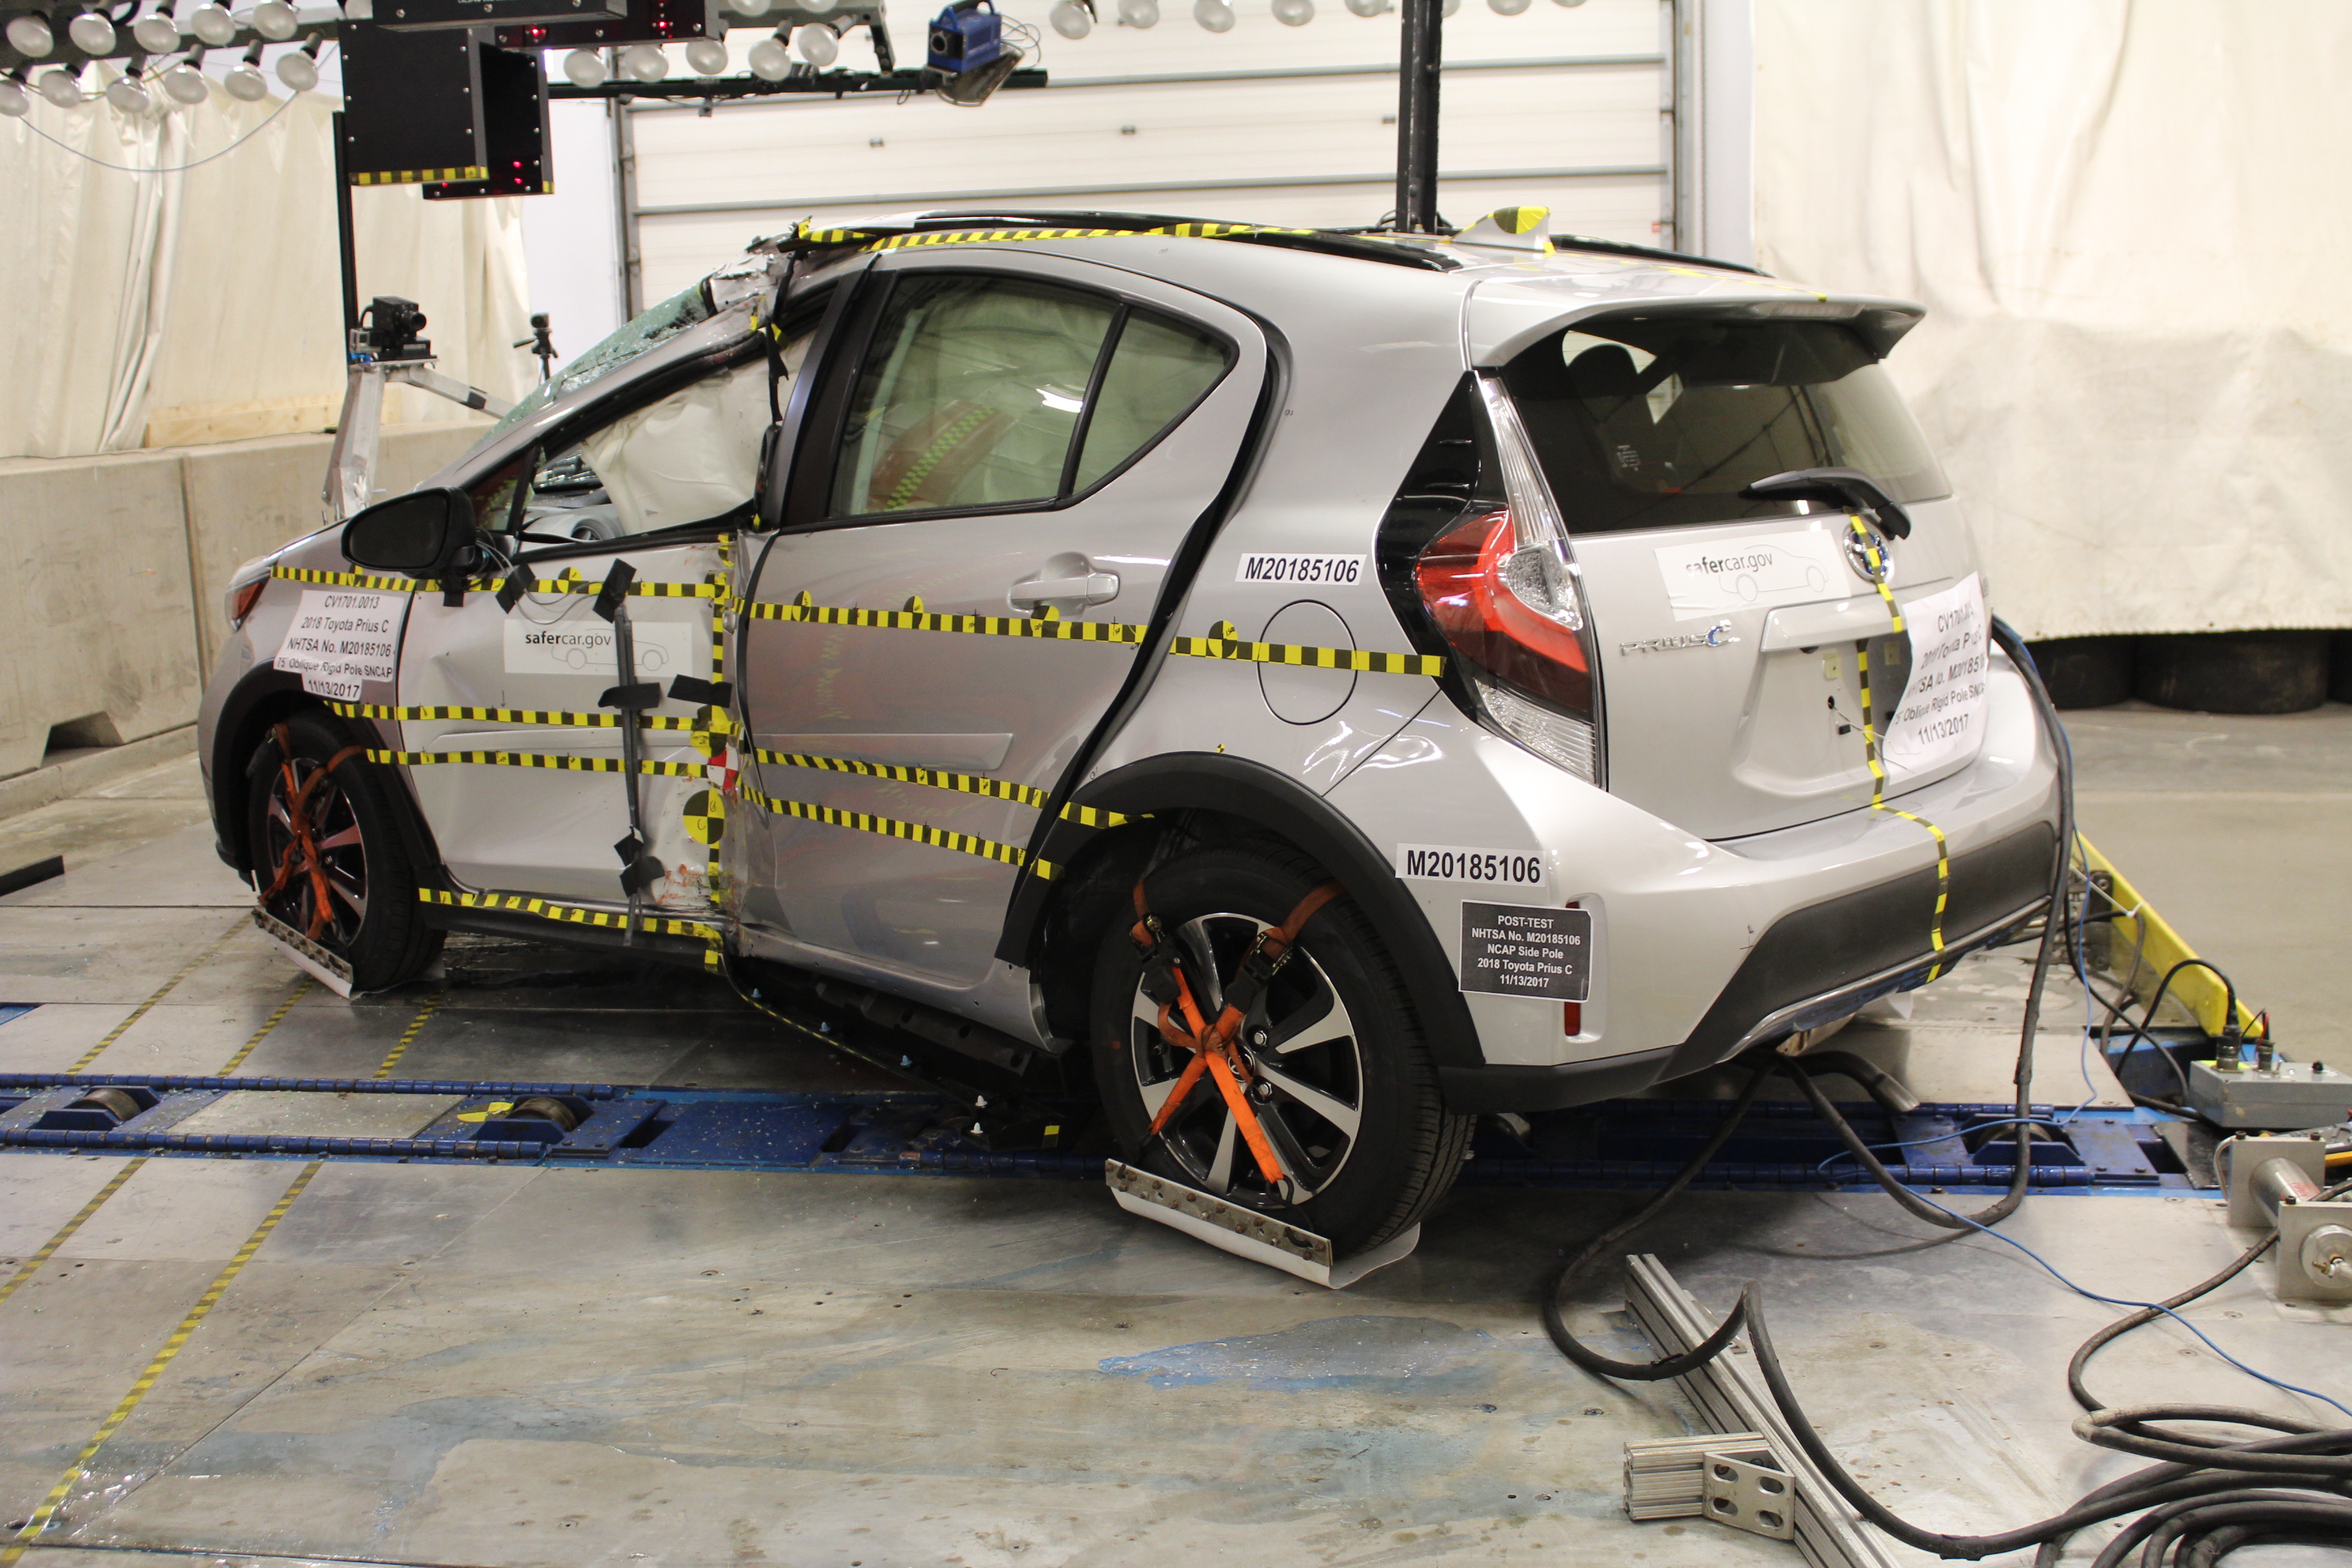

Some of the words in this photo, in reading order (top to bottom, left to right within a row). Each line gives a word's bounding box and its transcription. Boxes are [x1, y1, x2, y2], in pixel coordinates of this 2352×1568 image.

[1245, 557, 1359, 583] M20185106
[1685, 553, 1773, 574] safercar.gov
[325, 595, 380, 609] CV1701.0013
[301, 617, 323, 629] 2018
[323, 617, 353, 633] Toyota
[355, 619, 379, 633] Prius
[381, 619, 389, 633] C
[287, 637, 319, 651] NHTSA
[321, 639, 337, 653] No.
[340, 640, 391, 657] M20185106
[525, 631, 612, 648] safercar.gov
[289, 657, 319, 672] Oblique
[320, 662, 341, 674] Rigid
[344, 664, 362, 675] Pole
[365, 666, 393, 678] SNCAP
[308, 679, 359, 698] 11/13/2017
[1950, 687, 1968, 704] Pole
[1918, 713, 1970, 745] 11/13/2017
[1407, 850, 1541, 883] M20185106
[1497, 915, 1554, 929] POST-TEST
[1471, 928, 1506, 941] NHTSA
[1508, 930, 1524, 942] No.
[1526, 932, 1581, 946] M20185106
[1487, 944, 1516, 956] NCAP
[1518, 945, 1539, 958] Side
[1541, 947, 1564, 959] Pole
[1477, 958, 1501, 969] 2018
[1502, 958, 1535, 973] Toyota
[1537, 961, 1563, 975] Prius
[1565, 964, 1573, 975] C
[1499, 974, 1550, 988] 11/13/2017
